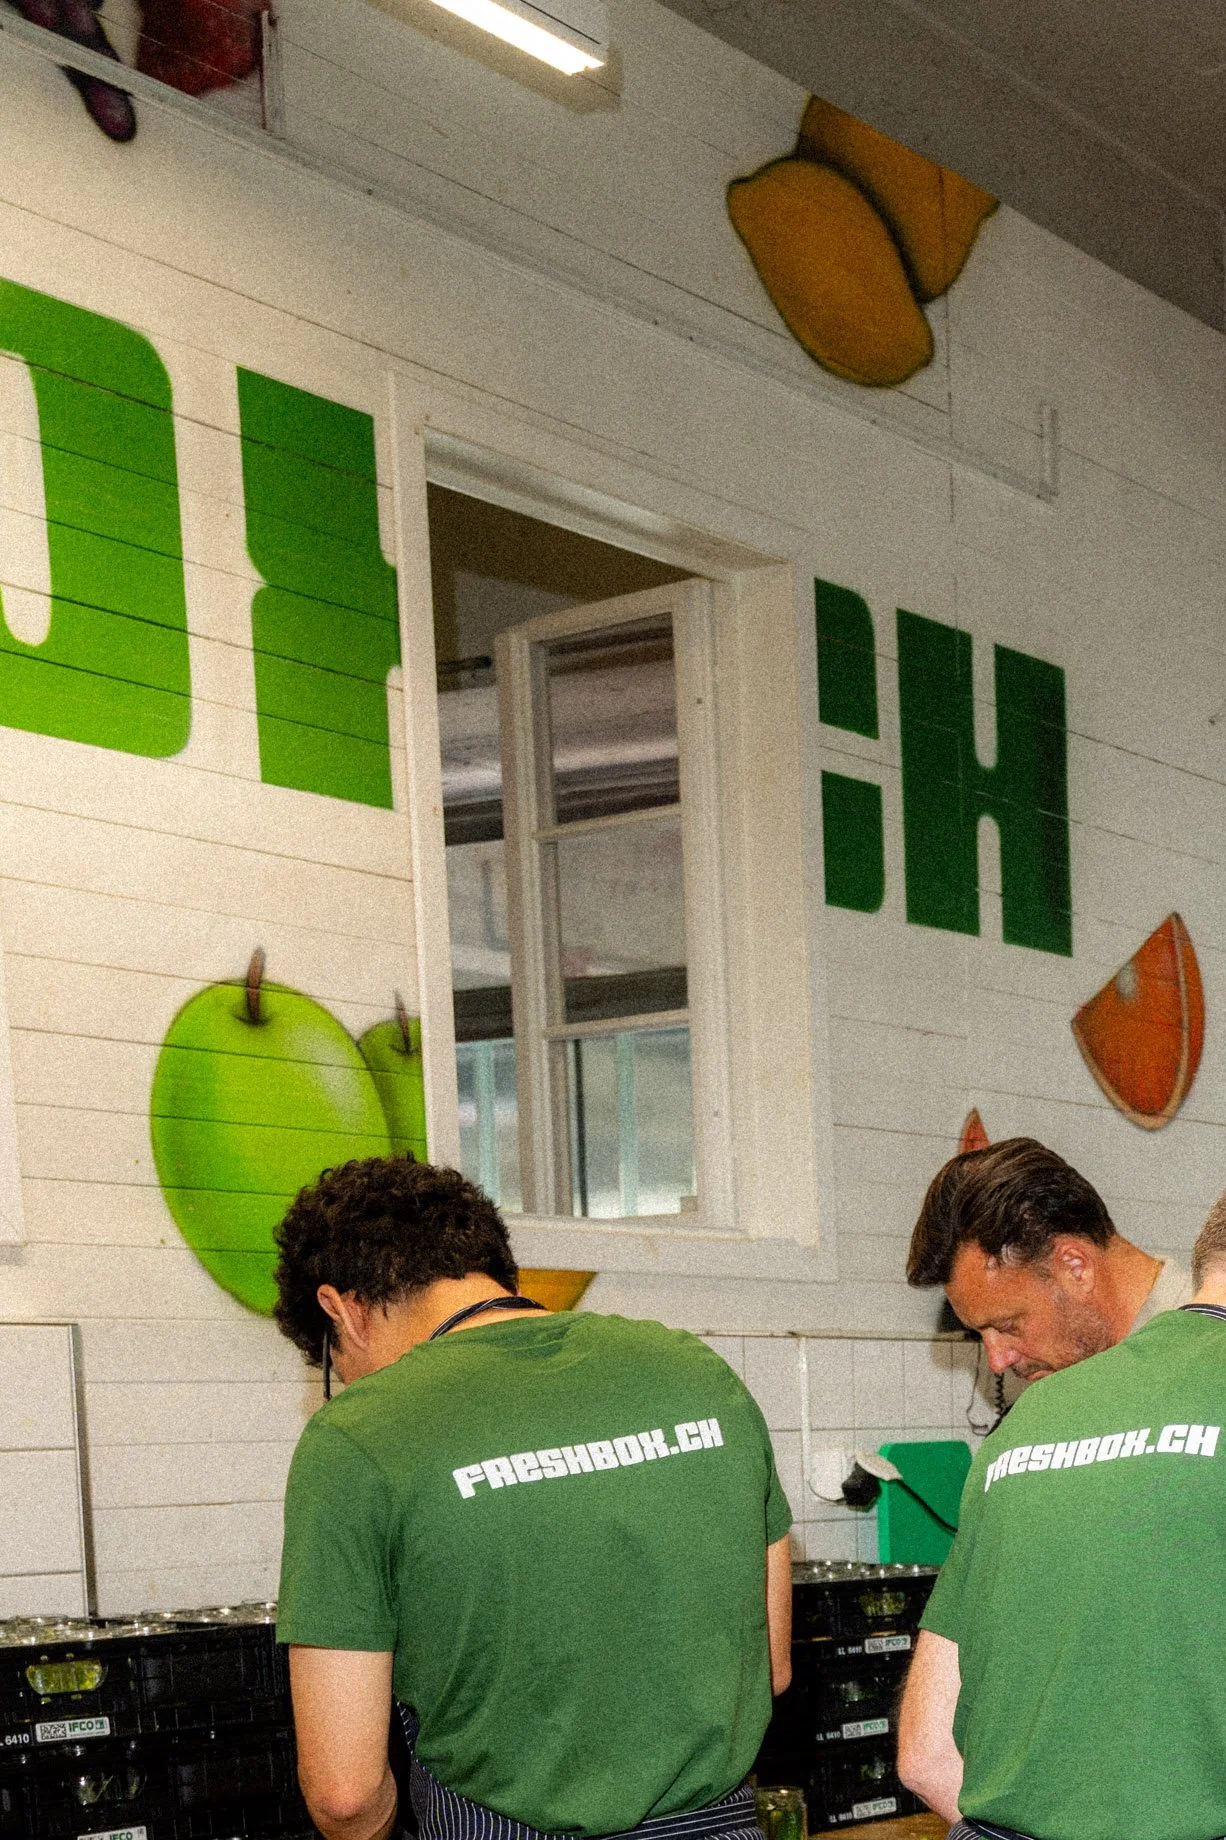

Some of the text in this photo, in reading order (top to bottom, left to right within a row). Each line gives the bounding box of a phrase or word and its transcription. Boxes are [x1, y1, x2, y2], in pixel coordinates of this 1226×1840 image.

[452, 1418, 724, 1499] FRESHBOX.CH
[68, 1720, 94, 1733] IFCO
[5, 1733, 30, 1746] 6410
